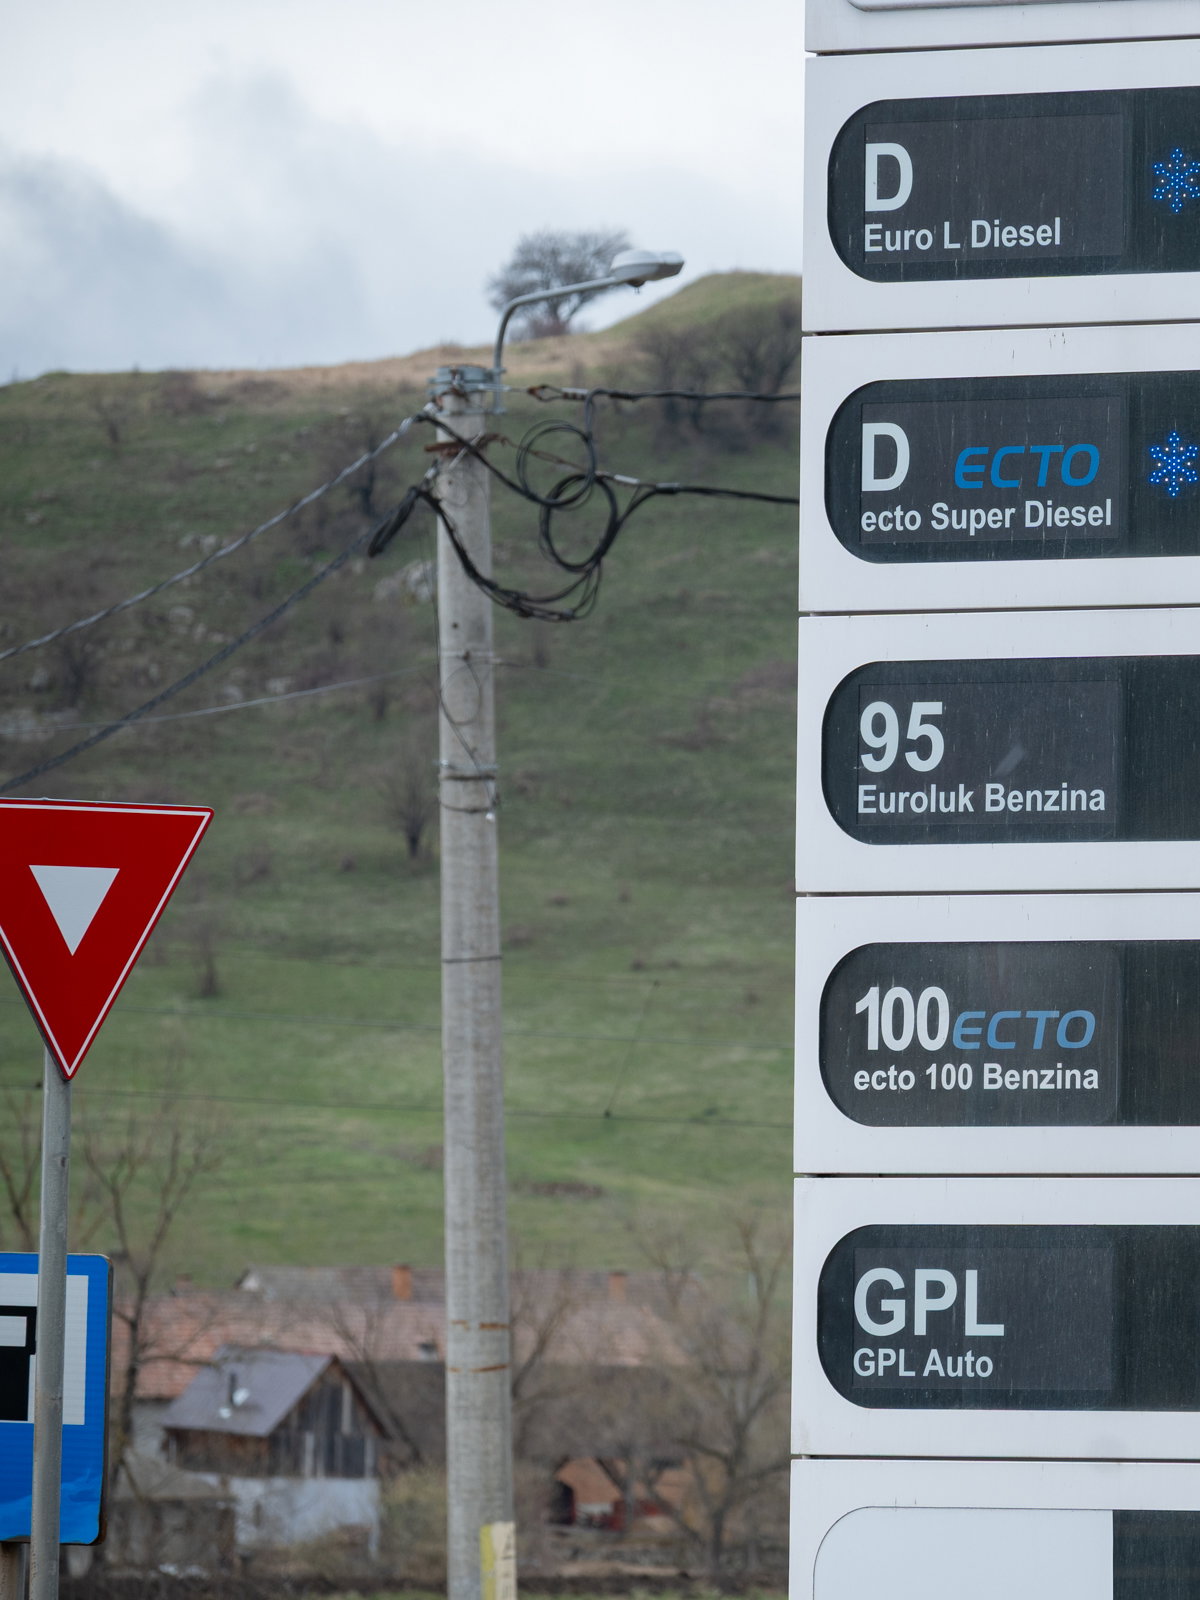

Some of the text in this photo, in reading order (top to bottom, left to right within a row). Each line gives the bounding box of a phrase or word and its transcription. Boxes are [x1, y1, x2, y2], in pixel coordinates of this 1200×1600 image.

[864, 142, 914, 212] D
[864, 216, 1061, 252] Euro L Diesel
[861, 422, 1100, 492] D ECTO
[860, 498, 1112, 536] ecto Super Diesel
[860, 701, 945, 773] 95
[857, 783, 1106, 814] Euroluk Benzina
[855, 984, 949, 1052] 100
[853, 1062, 1099, 1091] ecto 100 Benzina
[853, 1267, 1005, 1337] GPL
[853, 1347, 994, 1378] GPL Auto
